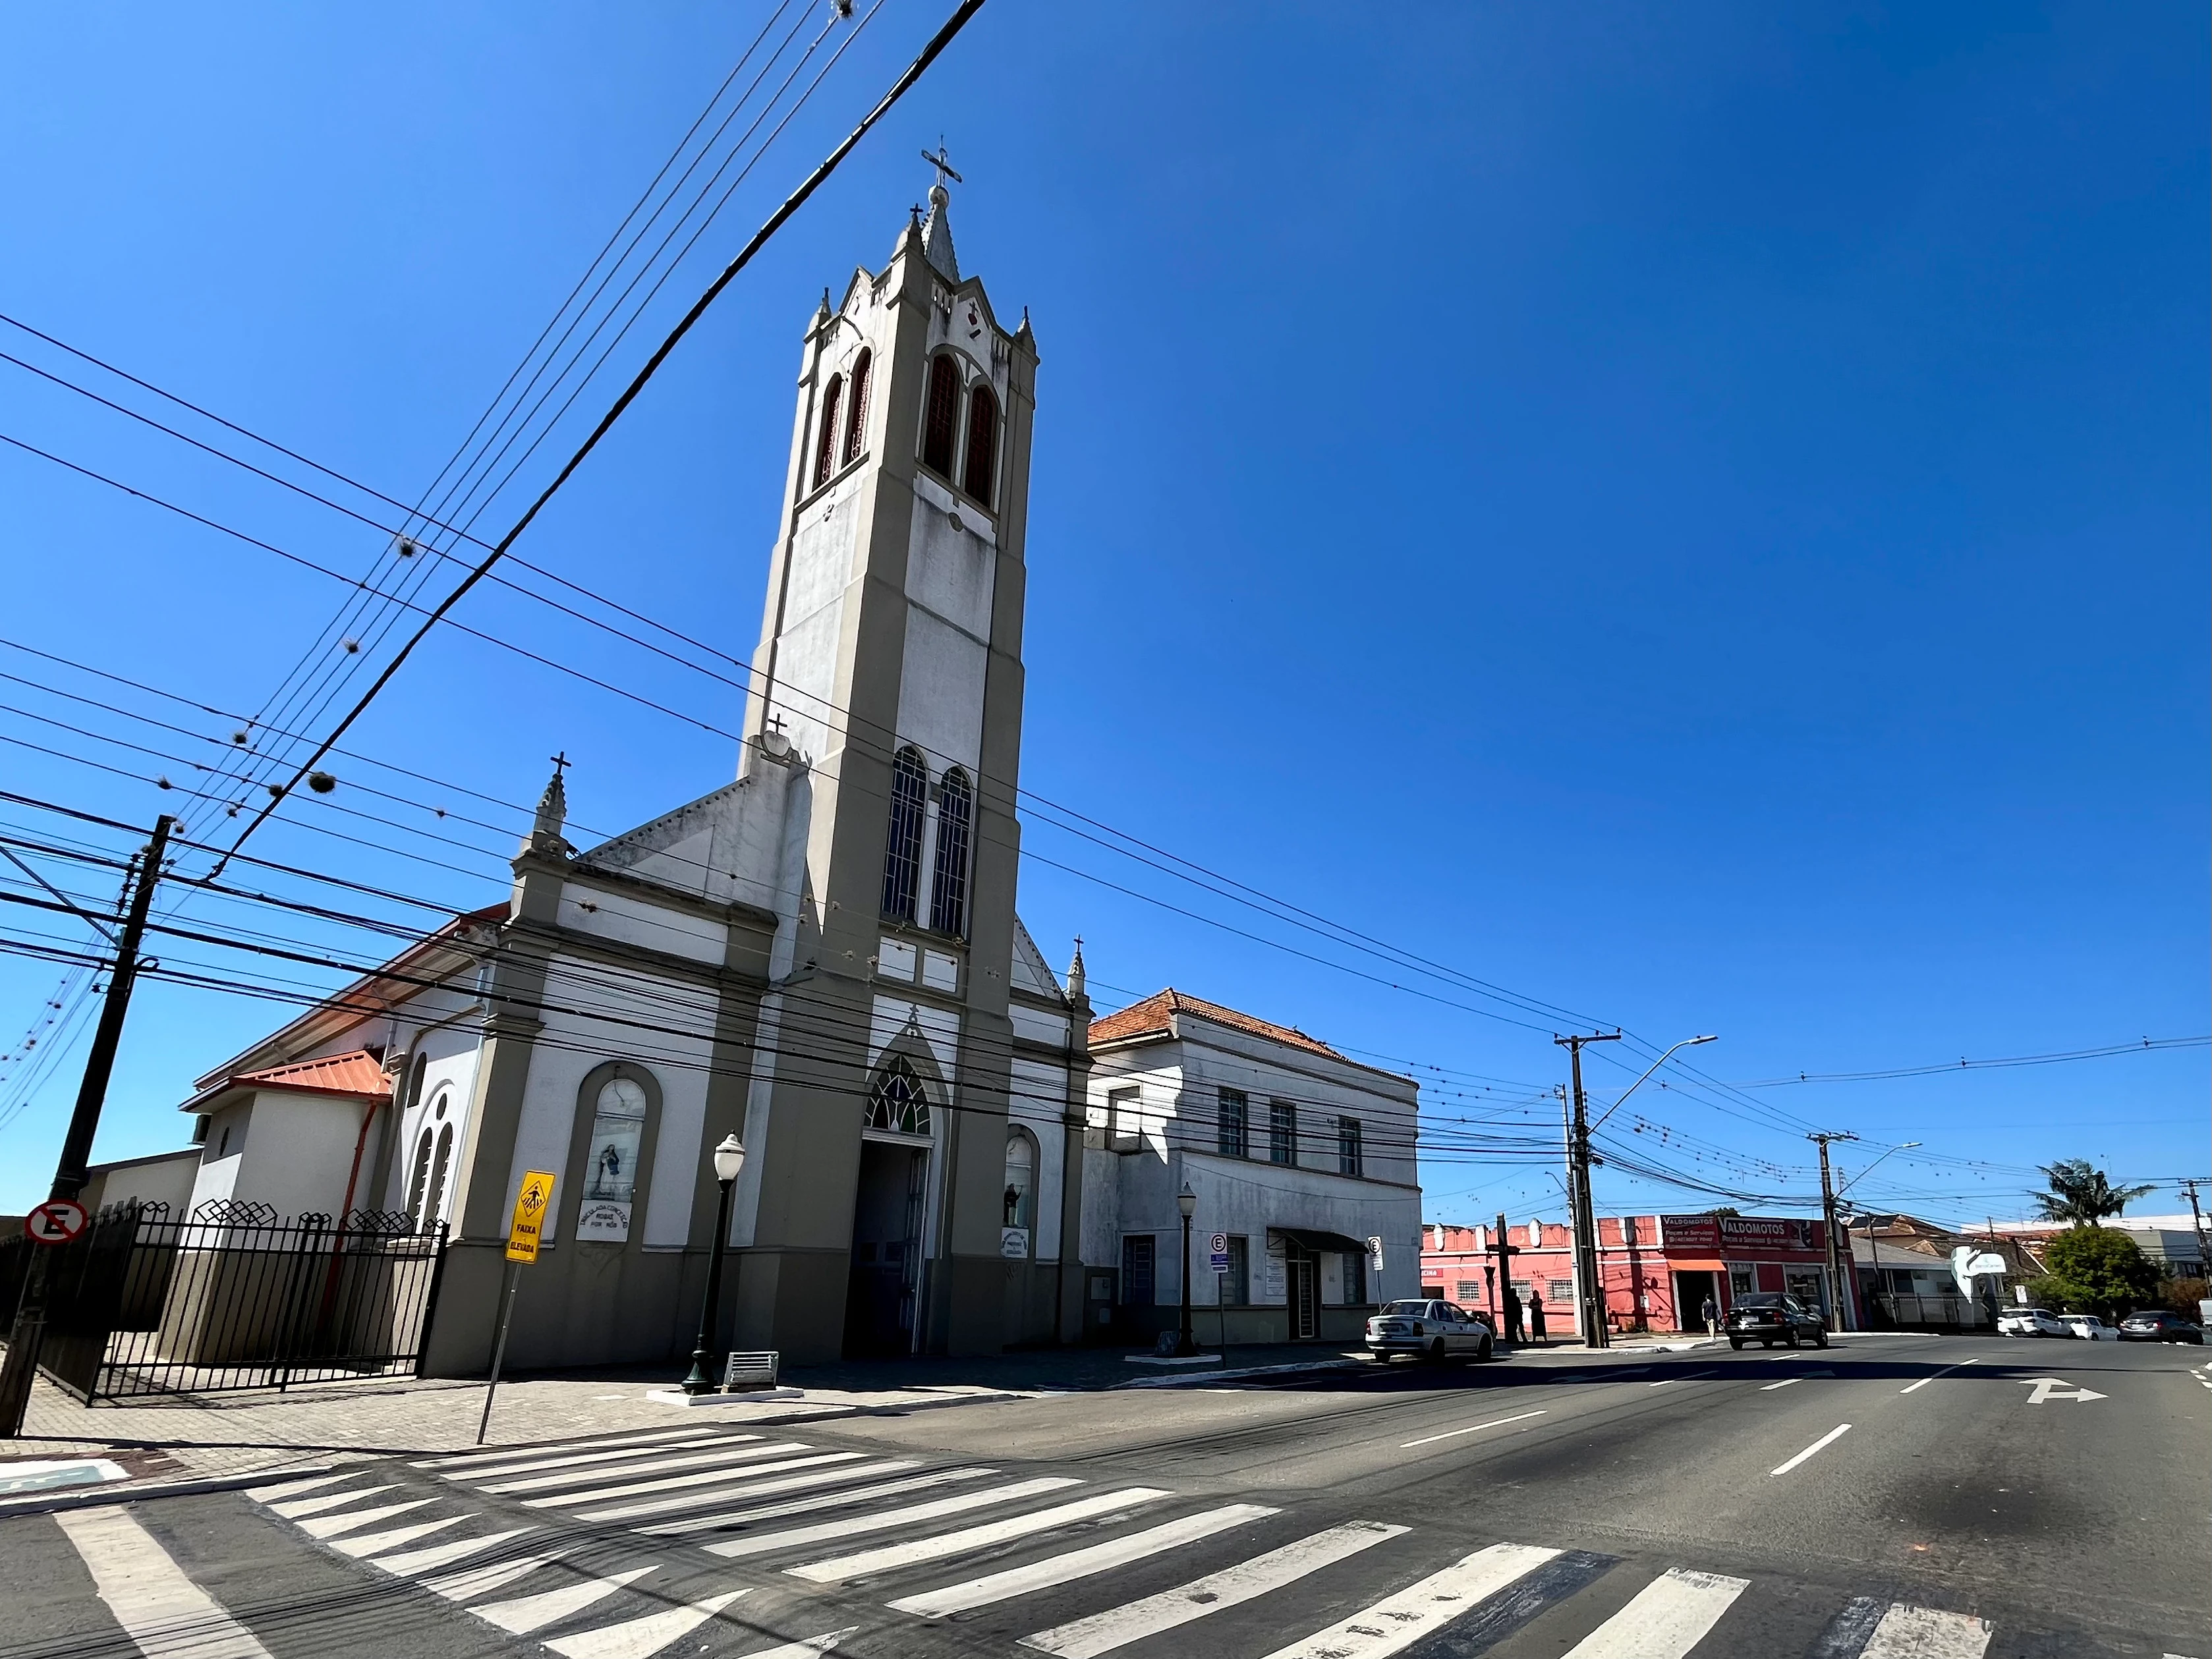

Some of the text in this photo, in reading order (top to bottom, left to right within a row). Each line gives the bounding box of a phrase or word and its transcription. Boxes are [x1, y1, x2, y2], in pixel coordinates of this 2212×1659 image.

[43, 1209, 69, 1234] E
[1662, 1216, 1714, 1225] VALDOMOTOS
[1717, 1216, 1785, 1235] VALDOMOTOS
[517, 1223, 536, 1235] FAIXA
[509, 1241, 534, 1253] ELEVADA
[1215, 1238, 1222, 1248] E
[1372, 1241, 1377, 1251] E
